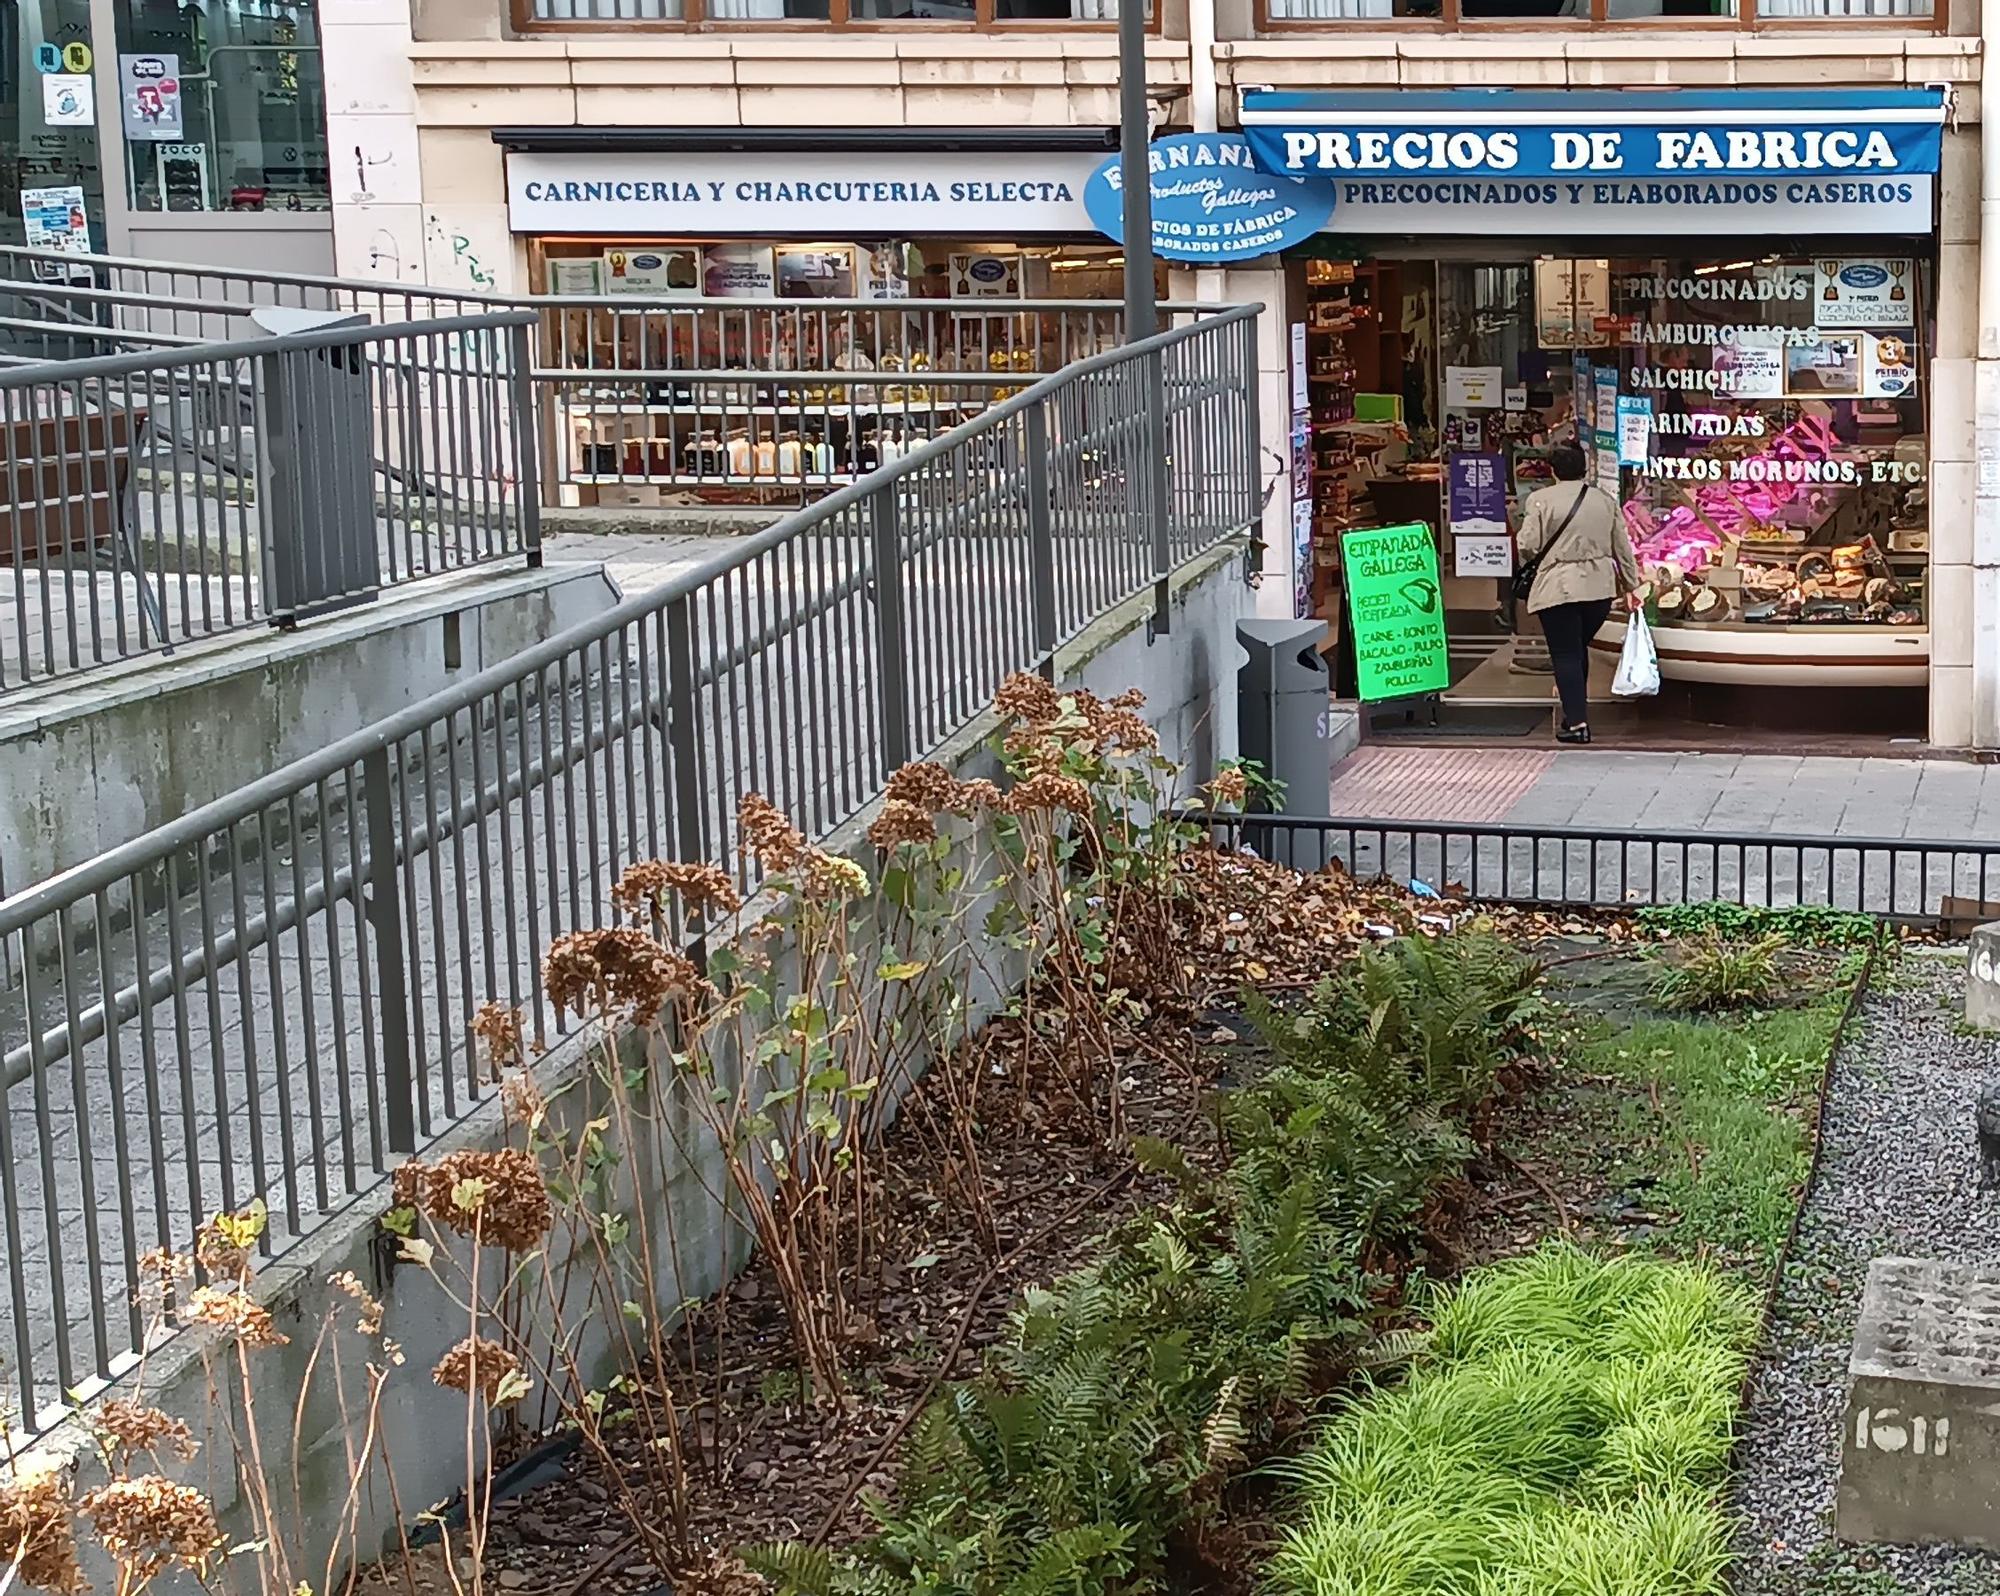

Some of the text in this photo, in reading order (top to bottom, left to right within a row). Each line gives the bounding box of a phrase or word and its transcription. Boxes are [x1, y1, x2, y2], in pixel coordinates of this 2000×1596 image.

[1282, 131, 1899, 170] PRECIOS DE FABRICA
[525, 181, 1074, 203] CARNICERIA Y CHARCUTERIA SELECTA
[1202, 187, 1277, 215] Gallegos
[1343, 183, 1913, 205] PRECOCINADOS Y ELABORADOS CASEROS
[1196, 221, 1220, 236] DE
[1629, 277, 1808, 301] PRECOCINADOS
[1630, 366, 1774, 393] SALCHICHAS
[1646, 412, 1766, 437] ARINADAS
[1729, 460, 1863, 488] MORUNOS,
[1870, 462, 1927, 484] ETC.
[1349, 532, 1433, 558] EMPANADA
[1361, 554, 1427, 577] GALLEGA
